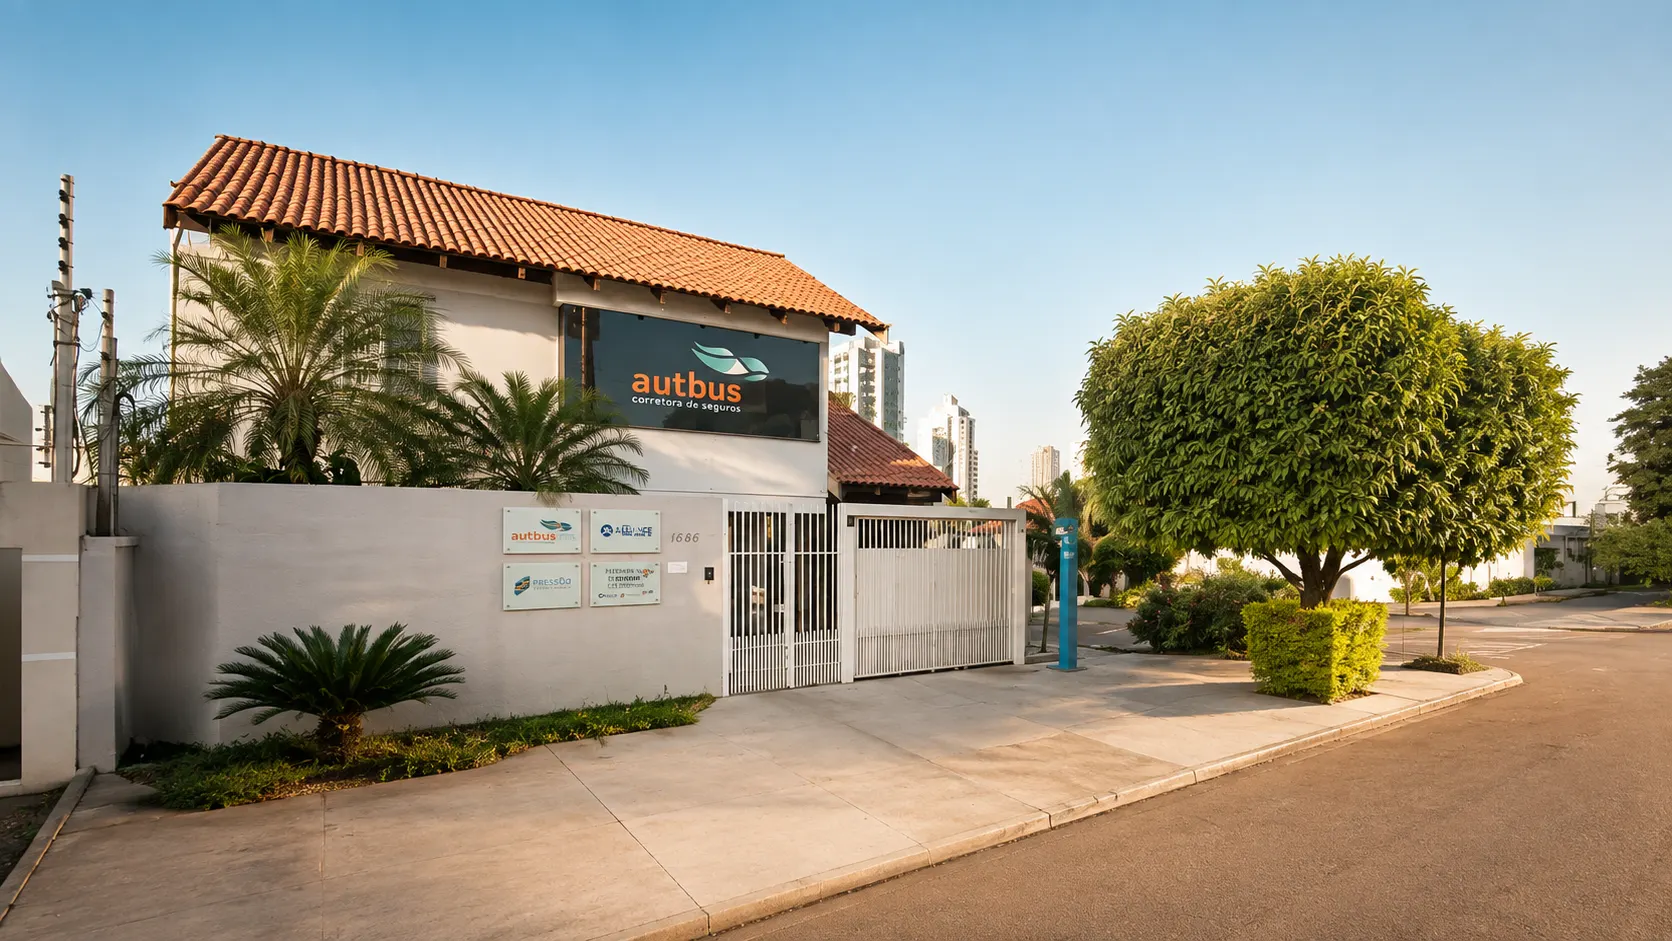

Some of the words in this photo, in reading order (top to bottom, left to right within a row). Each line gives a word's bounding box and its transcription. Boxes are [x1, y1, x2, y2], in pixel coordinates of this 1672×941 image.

[632, 371, 742, 403] autbus
[632, 395, 683, 408] corretora
[686, 400, 699, 409] de
[702, 402, 741, 413] seguros
[511, 531, 557, 541] autbus
[671, 532, 700, 543] 1686
